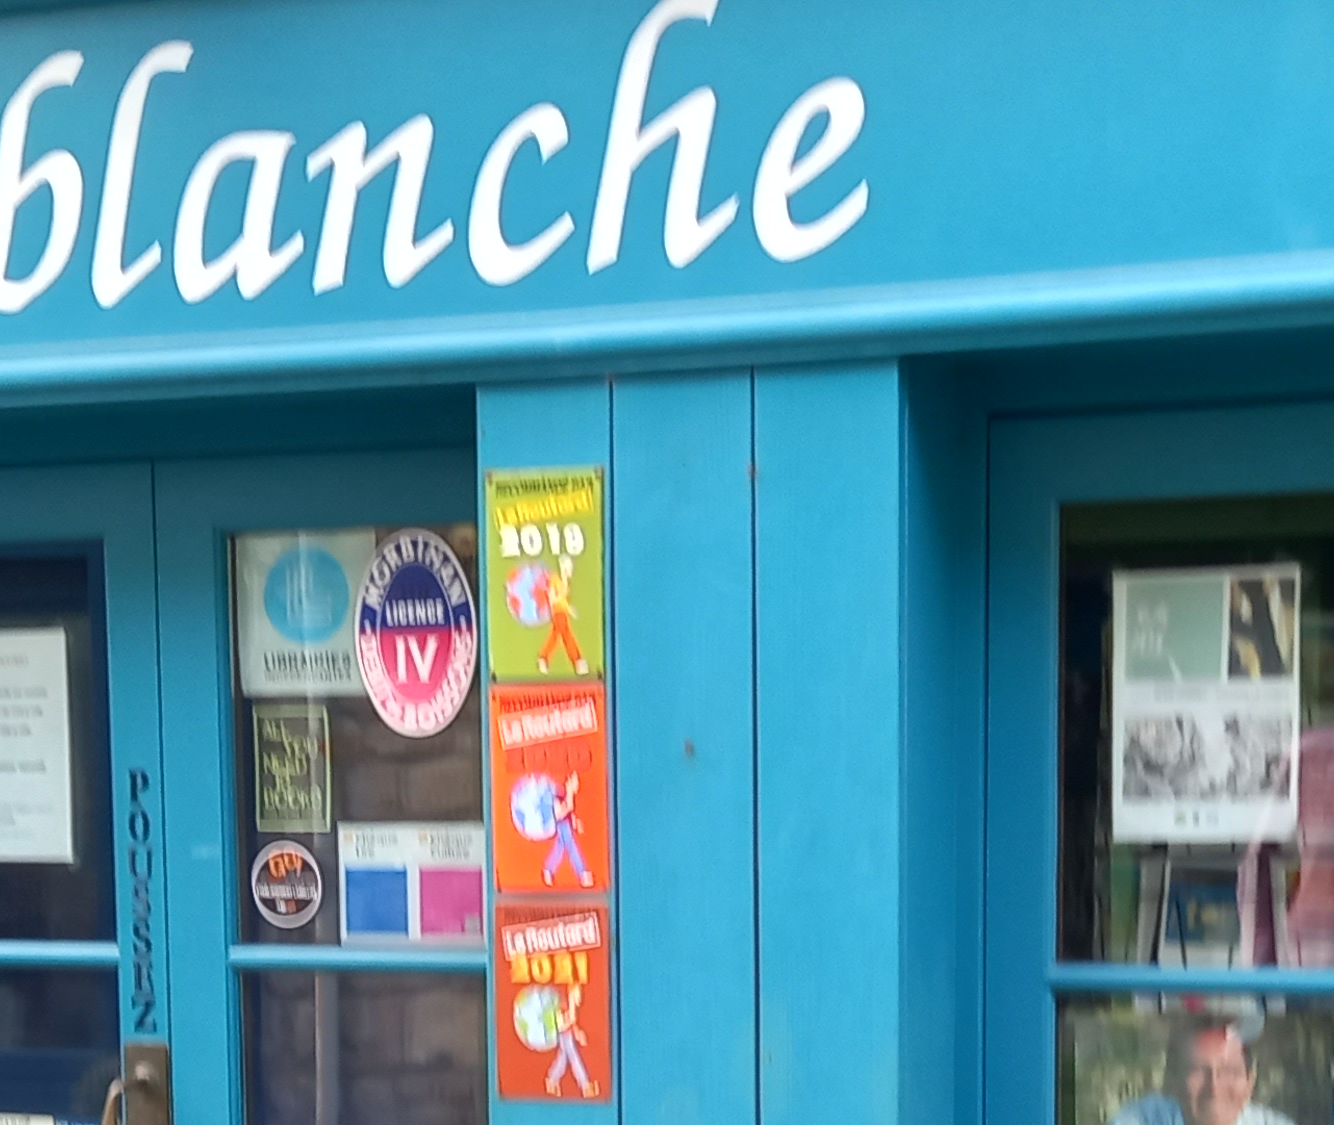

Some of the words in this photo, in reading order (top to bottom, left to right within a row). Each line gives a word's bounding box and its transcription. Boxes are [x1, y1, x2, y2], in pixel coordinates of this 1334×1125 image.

[516, 488, 590, 524] Routard
[498, 521, 585, 558] 2019
[363, 534, 468, 607] MORBIHAN
[385, 597, 445, 627] LICENCE
[394, 633, 440, 684] IV
[521, 701, 593, 742] Routard
[128, 767, 158, 1035] POUSSEZ
[506, 930, 526, 956] Le
[525, 917, 596, 953] Routard
[510, 951, 588, 985] 2021
